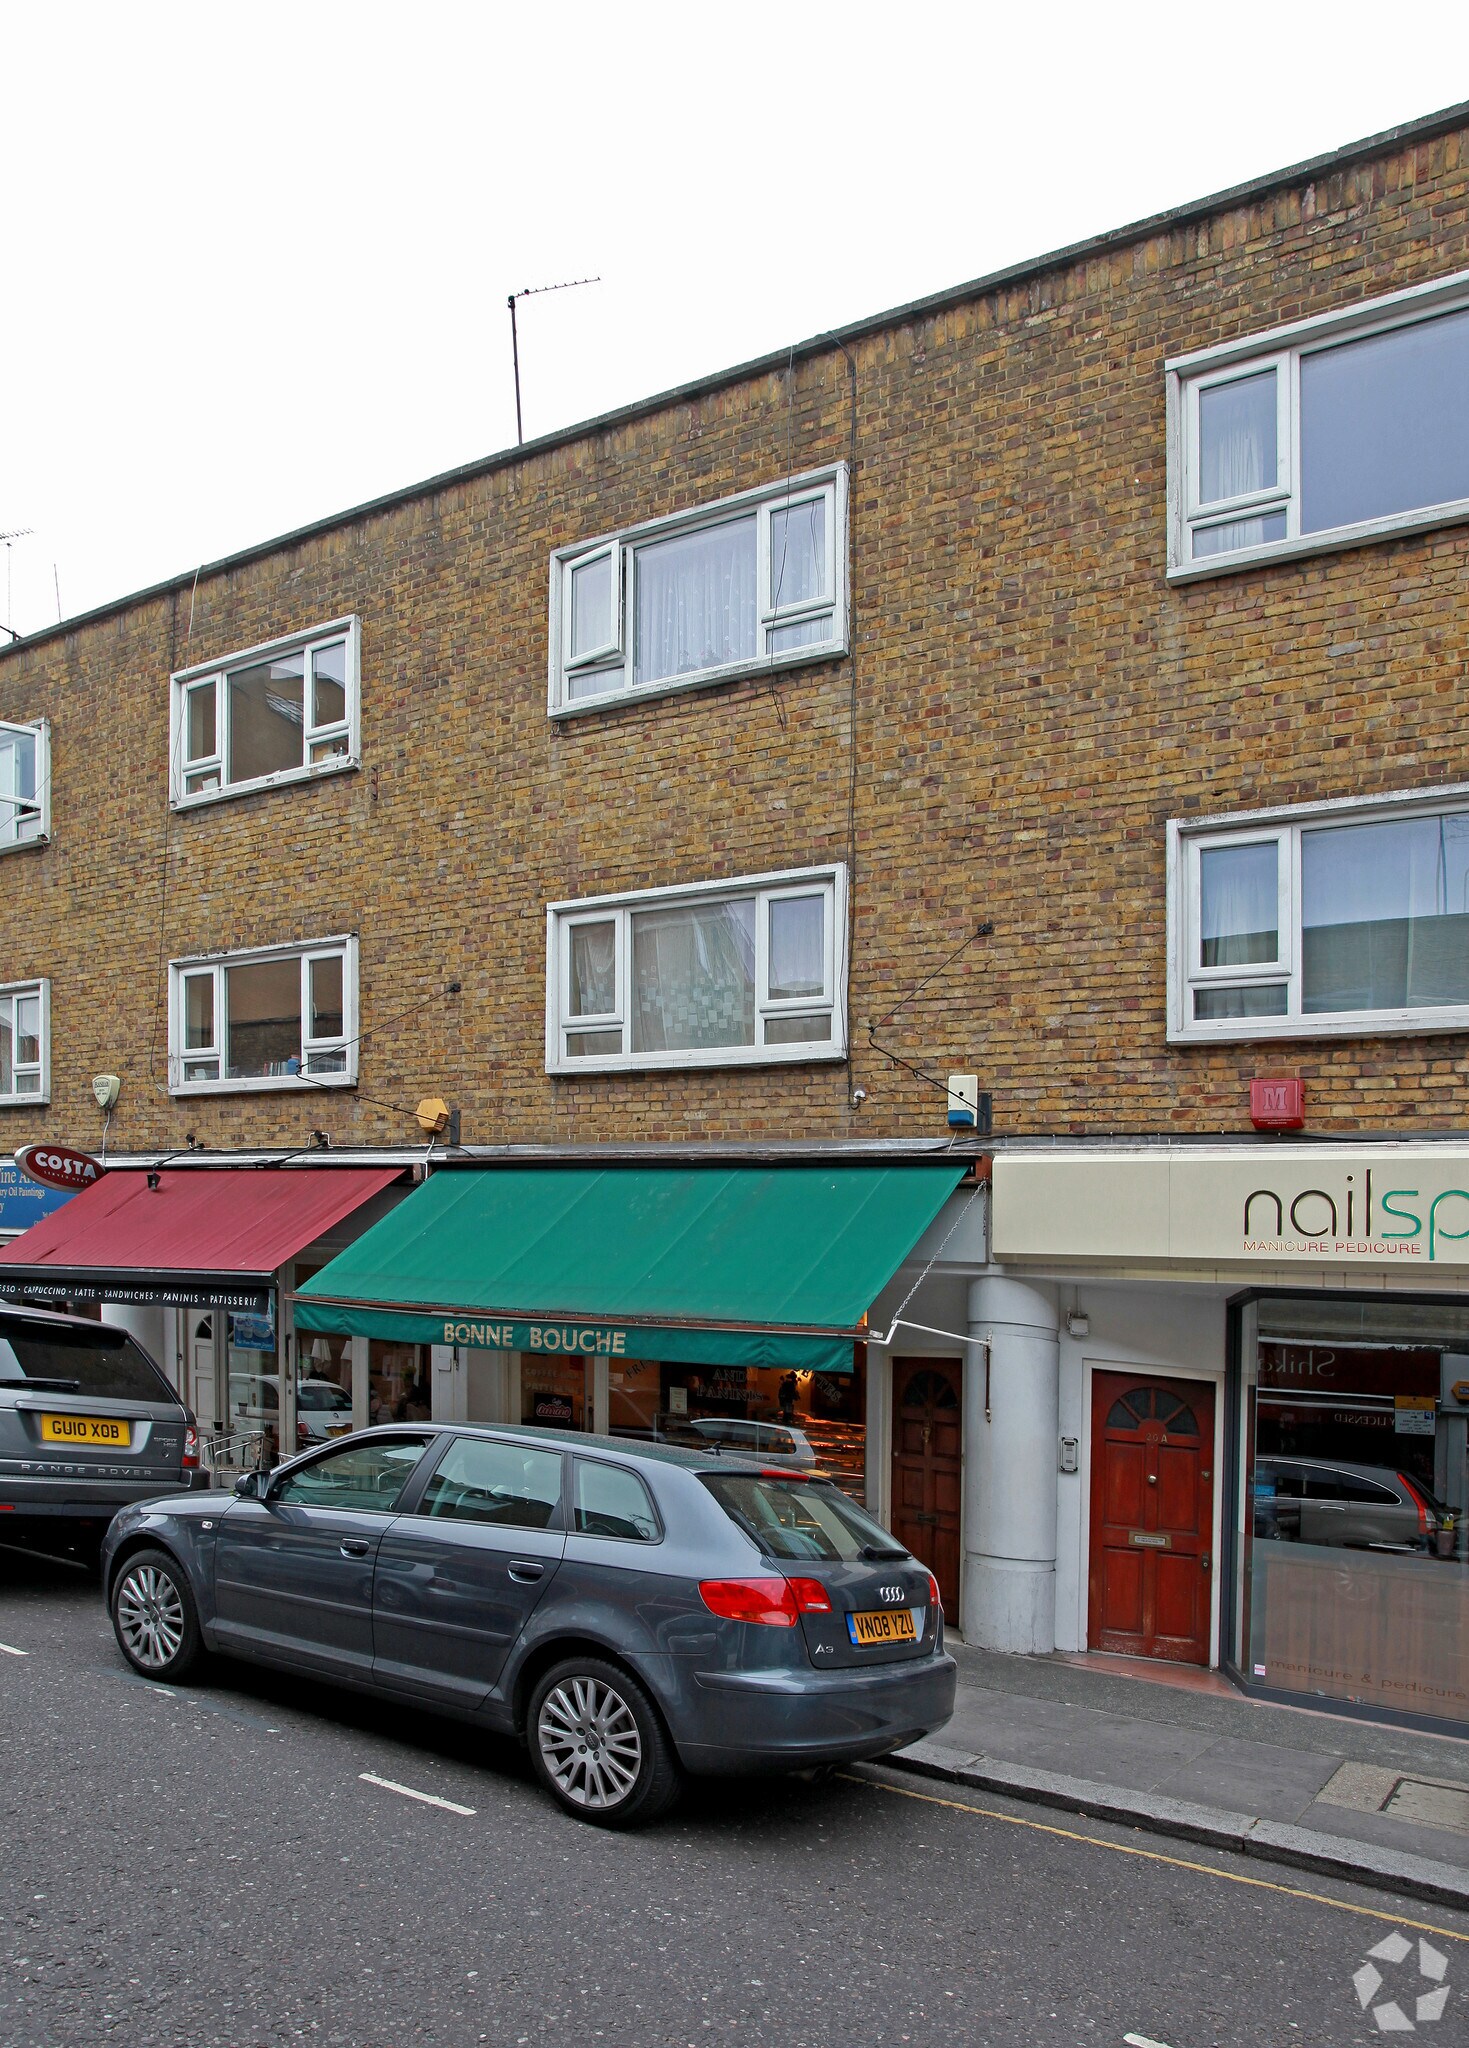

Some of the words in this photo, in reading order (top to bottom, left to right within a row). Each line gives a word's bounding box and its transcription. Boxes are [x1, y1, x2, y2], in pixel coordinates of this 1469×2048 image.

[35, 1152, 96, 1179] COSTA
[0, 1167, 17, 1183] ine
[8, 1186, 18, 1196] Oil
[18, 1186, 45, 1199] Paintings
[1243, 1241, 1329, 1253] MANICURE
[1335, 1242, 1421, 1254] PEDICURE
[23, 1285, 67, 1296] CAPPUCCINO
[74, 1288, 95, 1298] LATTE
[104, 1290, 154, 1300] SANDWICHES
[162, 1293, 199, 1303] PANINIS
[209, 1295, 257, 1306] PATISSERIE
[444, 1323, 514, 1347] BONNE
[530, 1327, 626, 1354] BOUCHE
[712, 1368, 747, 1383] AND
[52, 1420, 87, 1436] GU10
[91, 1424, 120, 1439] XOB
[21, 1463, 86, 1474] RANGE
[98, 1468, 152, 1476] ROVER
[855, 1615, 891, 1639] VN08
[890, 1613, 914, 1636] YZU
[814, 1643, 834, 1655] A3
[1270, 1659, 1353, 1681] manicure
[1360, 1673, 1373, 1685] &
[1381, 1678, 1466, 1700] pedicure
